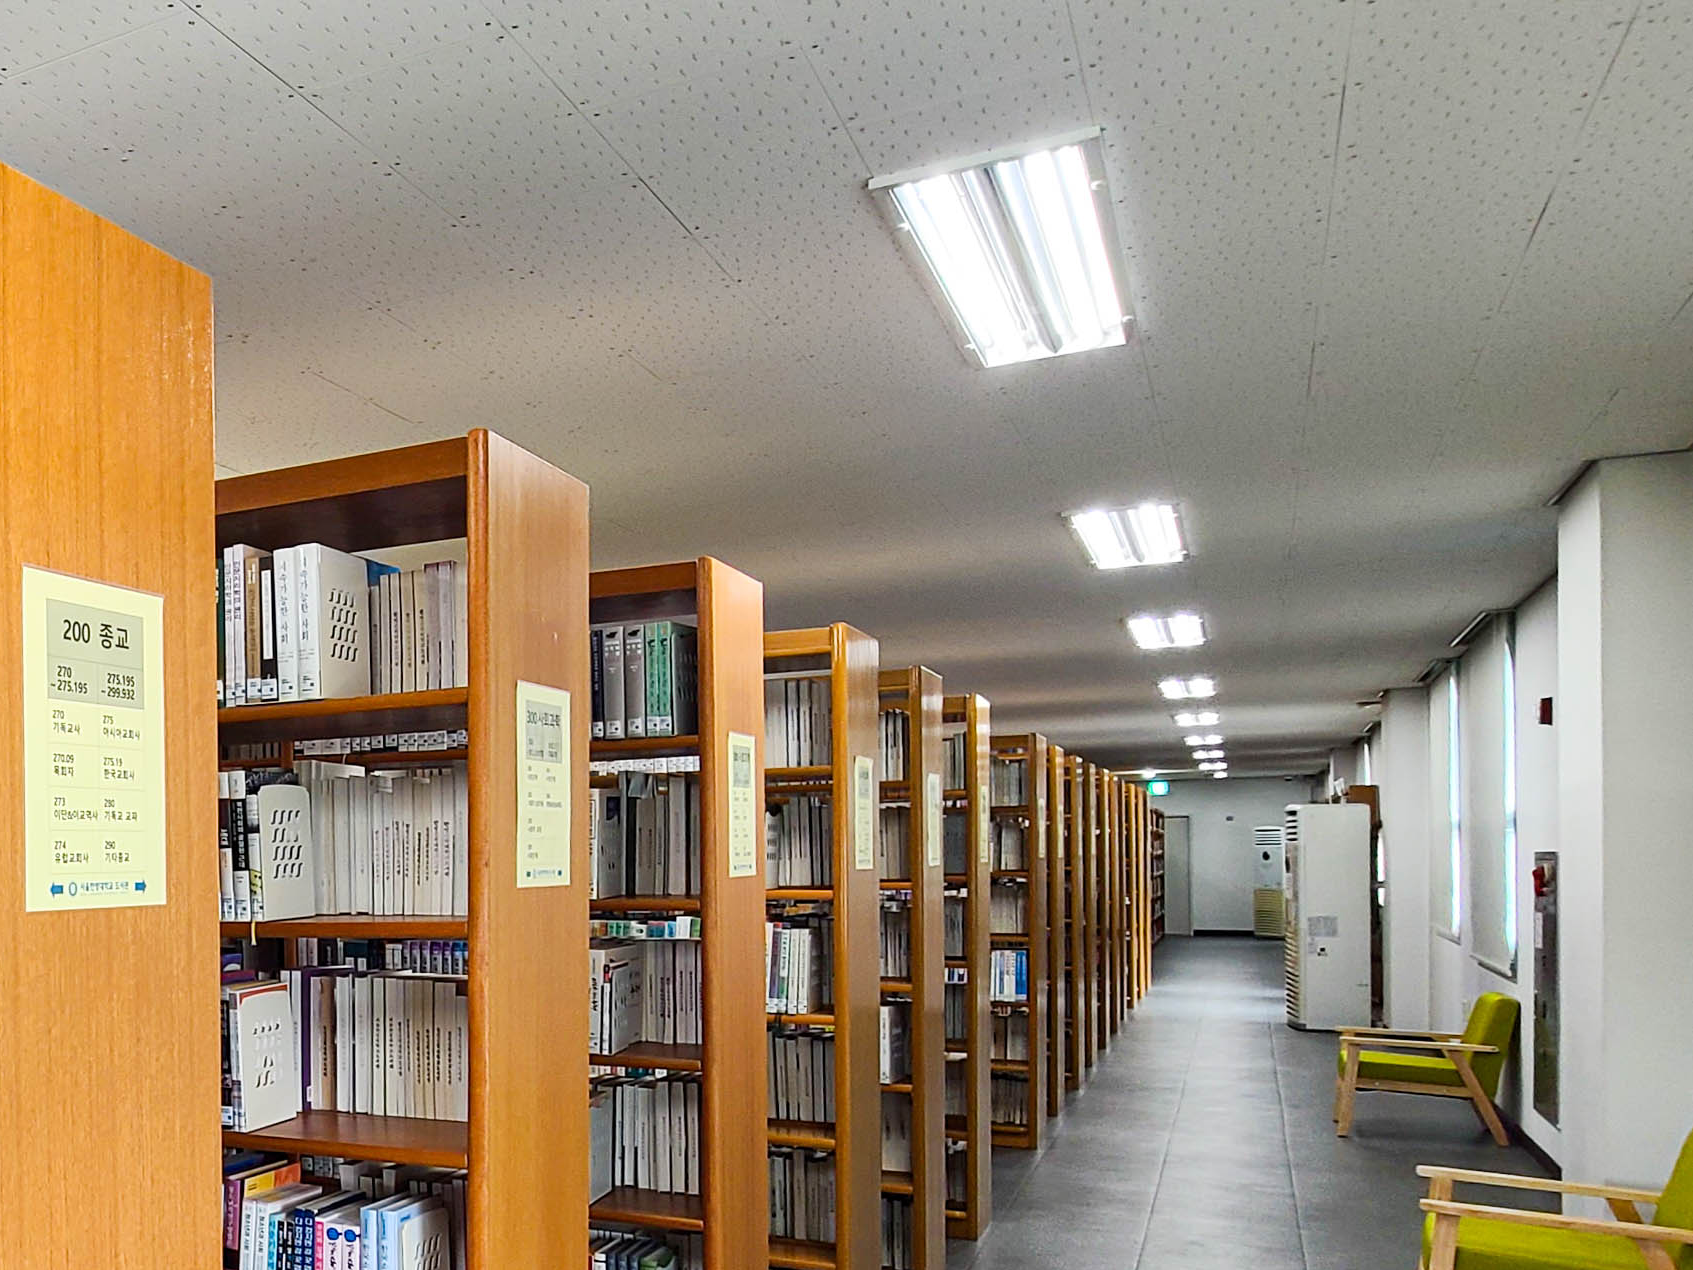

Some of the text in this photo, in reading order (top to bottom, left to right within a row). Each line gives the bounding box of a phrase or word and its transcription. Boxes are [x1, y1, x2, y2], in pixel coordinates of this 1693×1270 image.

[63, 619, 130, 650] 200 종교
[57, 665, 72, 679] 270
[107, 672, 135, 688] 275.195
[52, 709, 65, 720] 270
